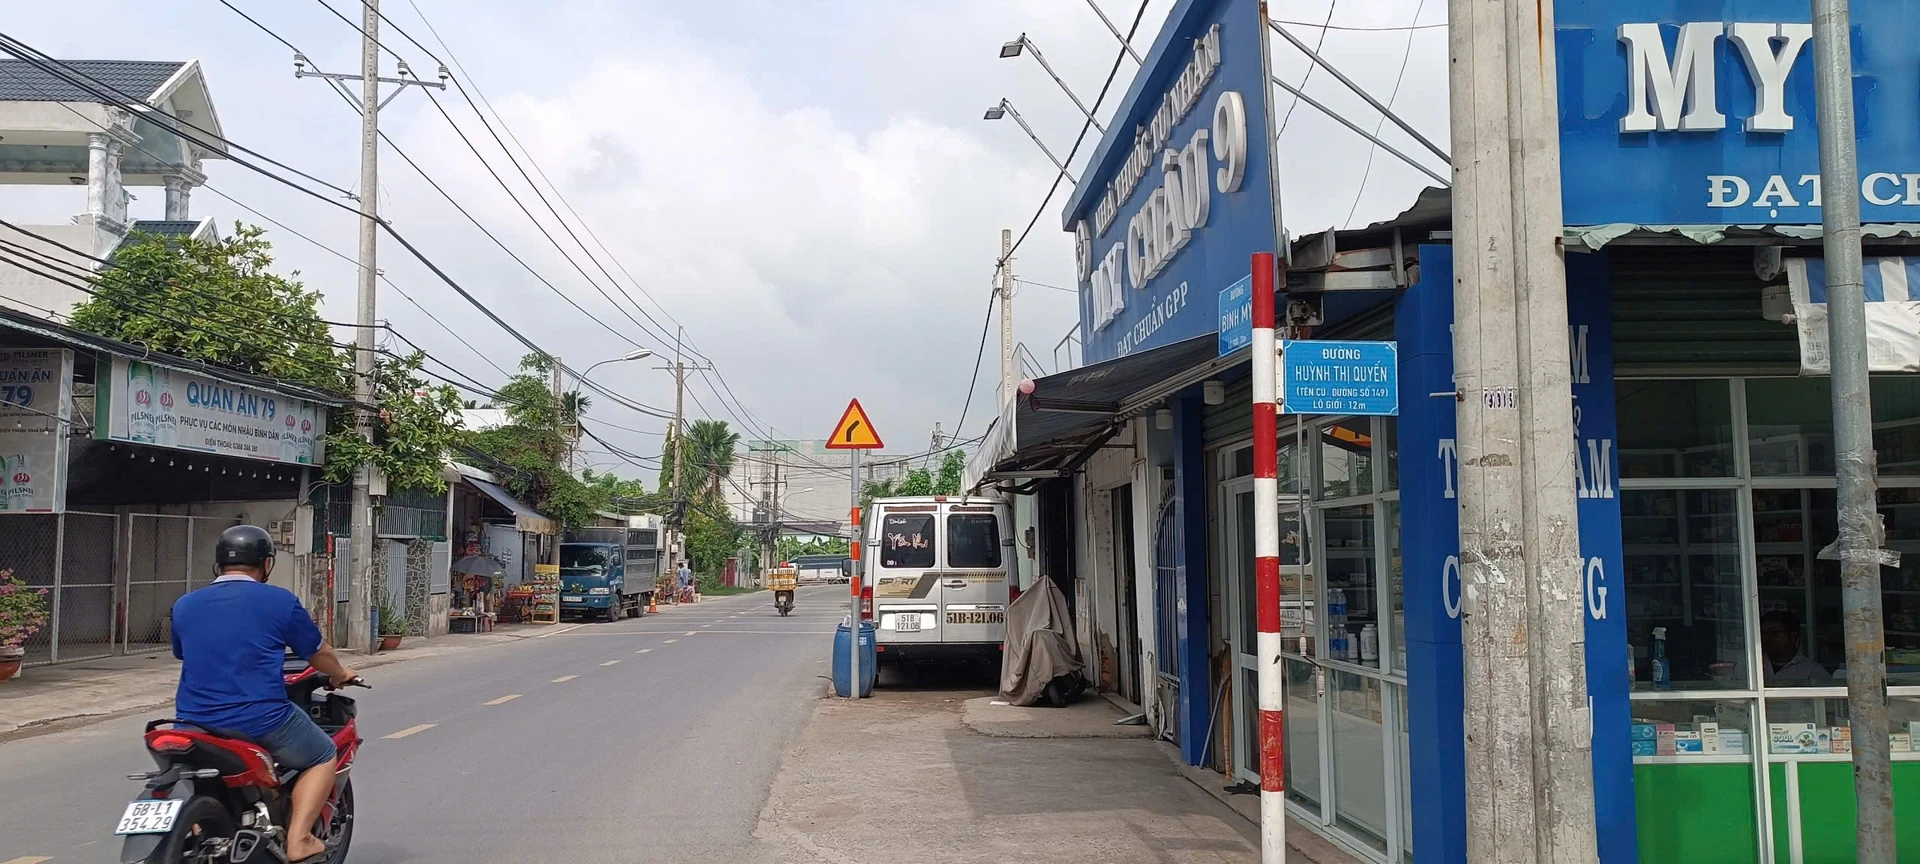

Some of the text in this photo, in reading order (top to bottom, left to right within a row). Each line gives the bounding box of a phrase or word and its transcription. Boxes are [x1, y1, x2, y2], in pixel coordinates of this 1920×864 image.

[1617, 22, 1812, 134] MY
[1095, 23, 1221, 239] NHÀ THUỐC TƯ NHÂN
[1091, 91, 1247, 333] MY CHÂU 9
[1134, 295, 1165, 345] CHUẨN
[1166, 280, 1188, 319] GPP
[1222, 308, 1240, 333] BÌNH
[1322, 345, 1361, 360] ĐƯỜNG
[31, 367, 52, 381] ĂN
[1295, 360, 1388, 384] HUỲNH THỊ QUYẾN
[1, 385, 34, 409] 79
[186, 380, 276, 419] QUÁN ĂN 79
[1296, 386, 1314, 396] (TÊN
[1332, 386, 1358, 397] ĐƯỜNG
[1360, 385, 1371, 397] SỐ
[1372, 387, 1389, 398] 149)
[1313, 399, 1324, 410] LỘ
[1348, 401, 1366, 410] 12m
[181, 416, 198, 429] PHỤC
[199, 419, 208, 431] VỤ
[209, 420, 222, 431] CÁC
[223, 423, 237, 434] MÓN
[238, 426, 254, 438] NHẬU
[254, 428, 267, 438] BÌNH
[268, 430, 280, 440] DÂN
[232, 442, 243, 450] 0368
[901, 614, 915, 622] 51B
[946, 612, 1004, 624] 51B-121.06
[132, 802, 173, 816] 68-L1
[120, 816, 173, 831] 354.29
